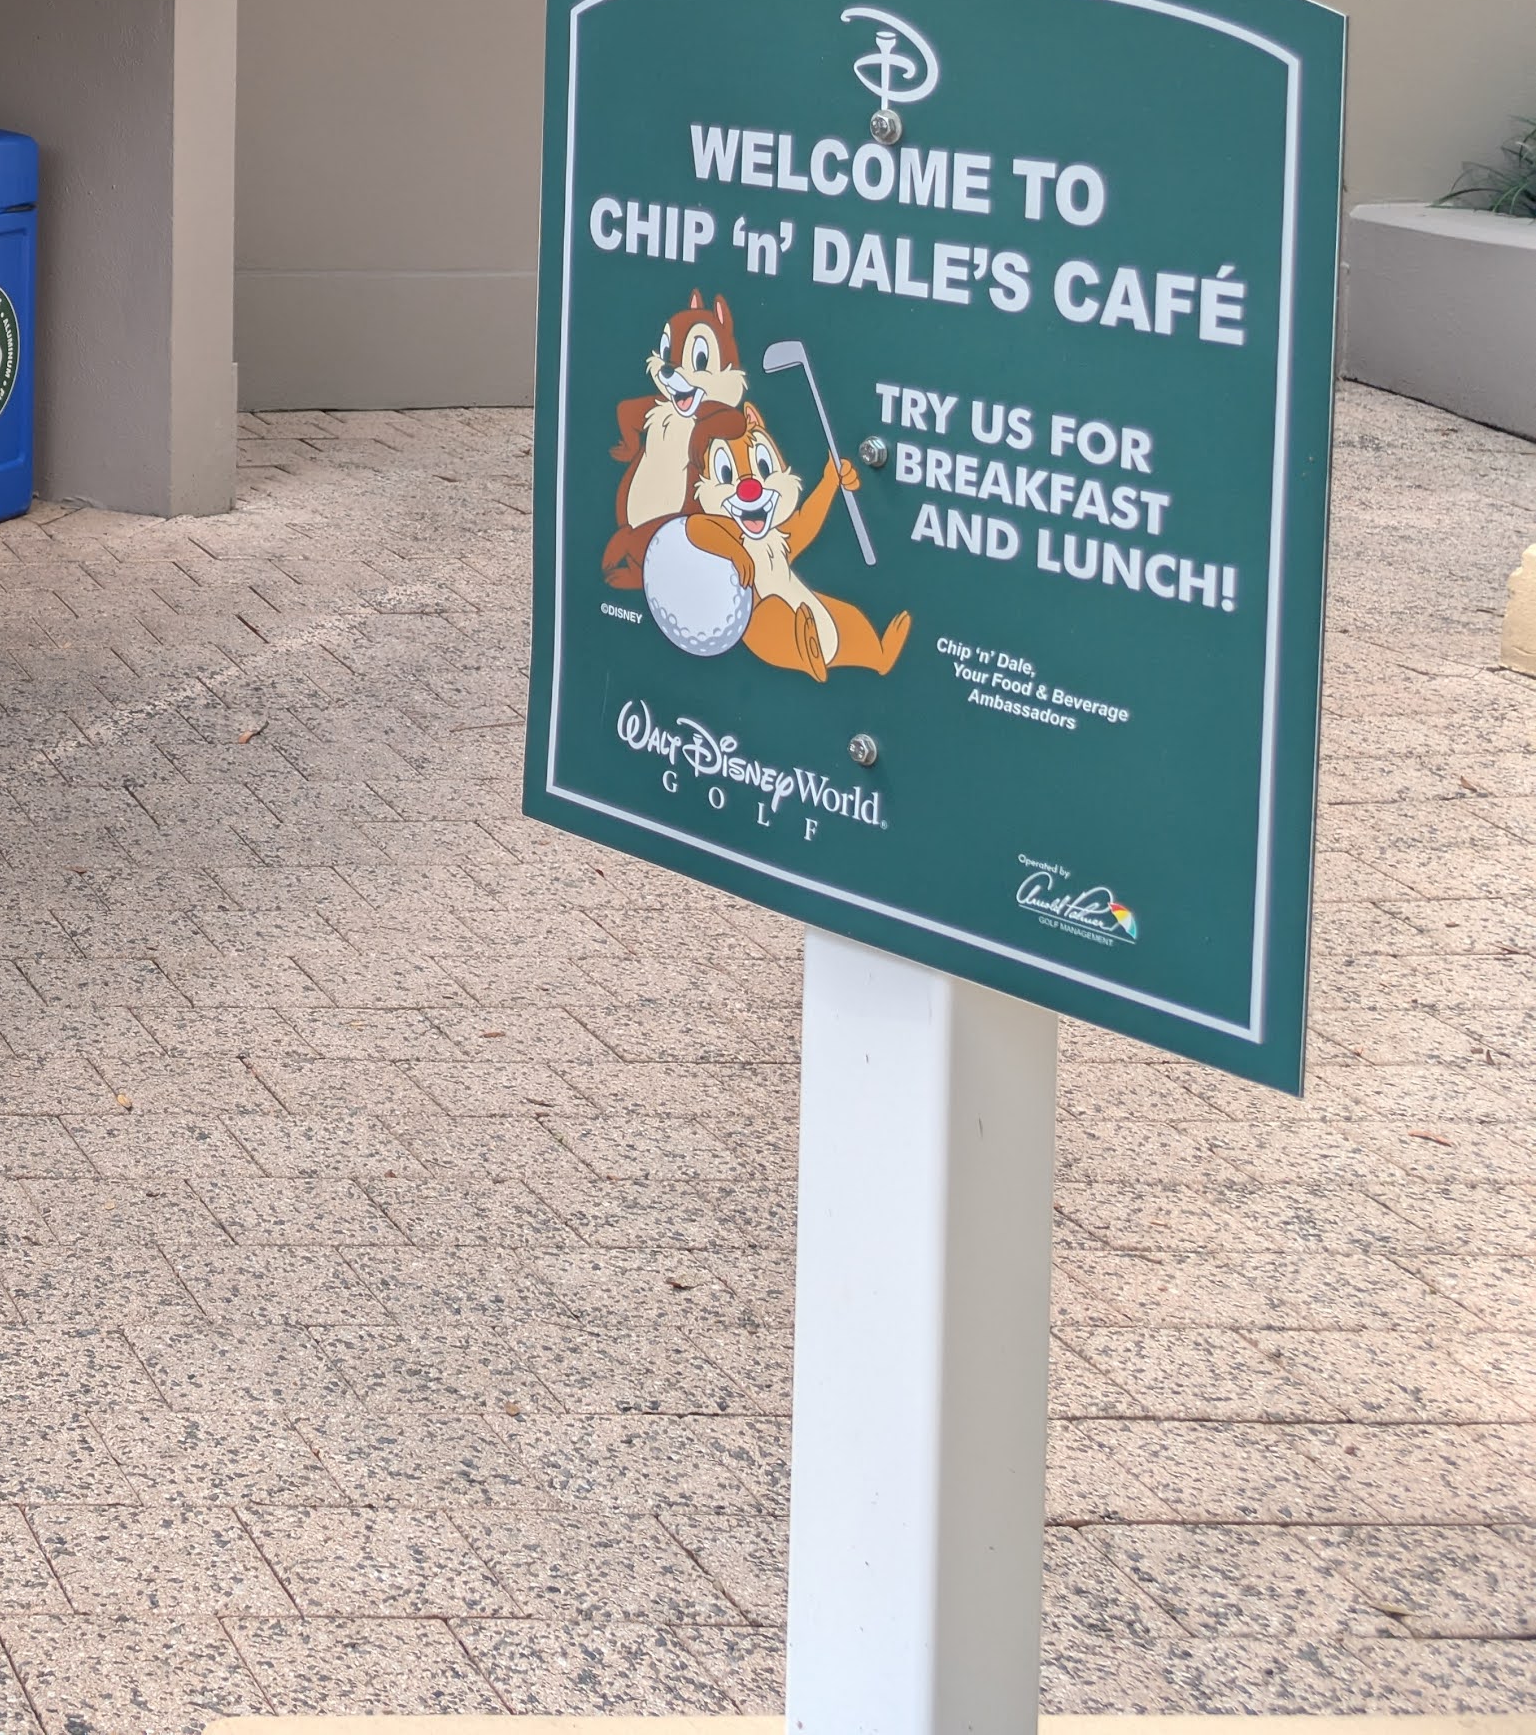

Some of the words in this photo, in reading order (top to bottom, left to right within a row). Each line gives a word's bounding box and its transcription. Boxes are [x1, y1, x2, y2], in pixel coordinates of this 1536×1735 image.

[690, 123, 990, 214] WELCOME
[1012, 159, 1104, 227] TO
[590, 197, 714, 263] CHIP
[813, 226, 1031, 313] DALE'S
[1054, 265, 1246, 347] CAFÉ
[3, 318, 14, 378] ALUMINUM
[876, 382, 957, 434] TRY
[971, 399, 1032, 451] US
[1050, 414, 1152, 473] FOR
[895, 442, 1169, 536] BREAKFAST
[911, 503, 1019, 561] AND
[1038, 528, 1239, 613] LUNCH!
[936, 637, 970, 663] Chip
[998, 652, 1036, 677] Dale,
[953, 662, 987, 685] Your
[991, 672, 1031, 694] Food
[1035, 681, 1047, 698] &
[1052, 686, 1129, 723] Beverage
[968, 689, 1077, 731] Ambassadors
[1018, 854, 1056, 877] Operated
[1059, 866, 1070, 879] by
[1038, 915, 1060, 932] GOLF
[1060, 922, 1114, 947] MANAGEMENT
